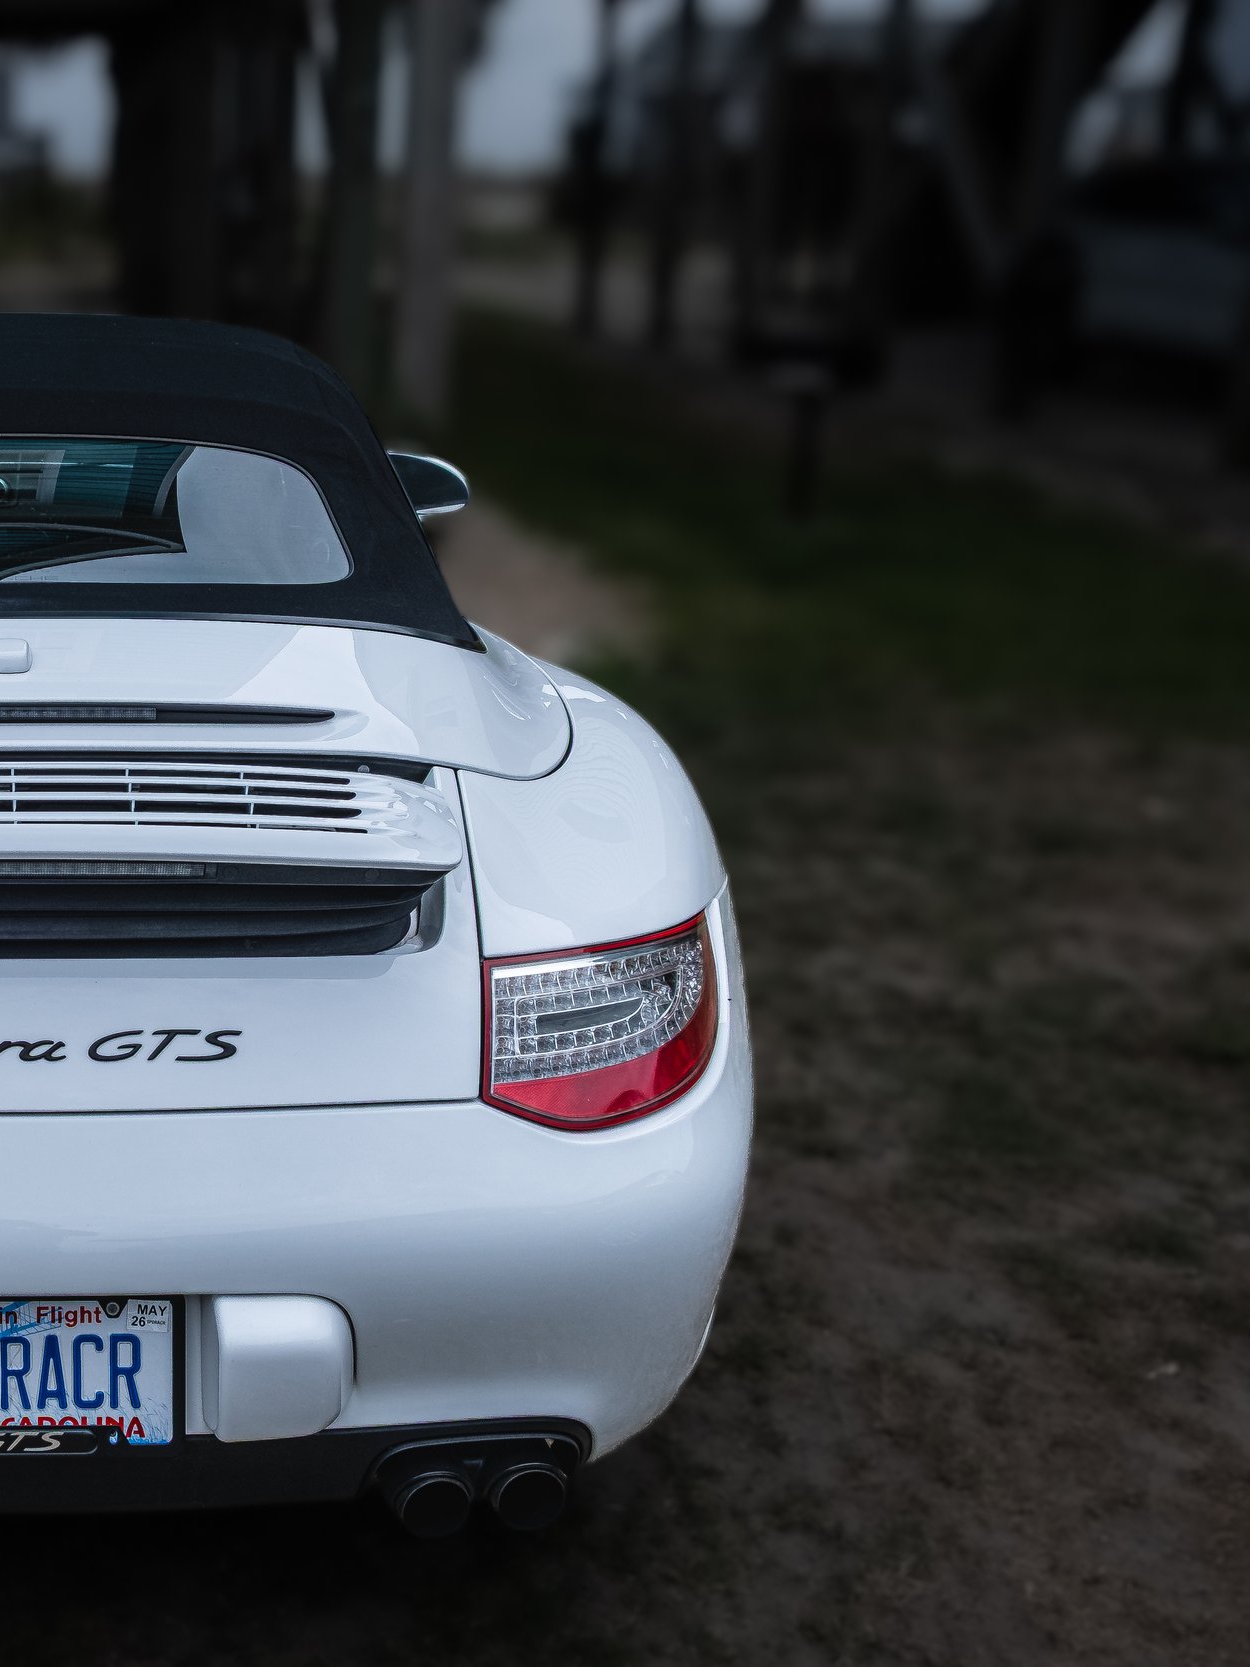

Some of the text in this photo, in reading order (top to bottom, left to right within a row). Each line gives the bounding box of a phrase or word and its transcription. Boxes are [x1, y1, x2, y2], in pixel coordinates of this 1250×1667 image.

[87, 1029, 243, 1062] GTS
[36, 1306, 102, 1328] Flight
[137, 1304, 168, 1317] MAY
[130, 1315, 146, 1327] 26
